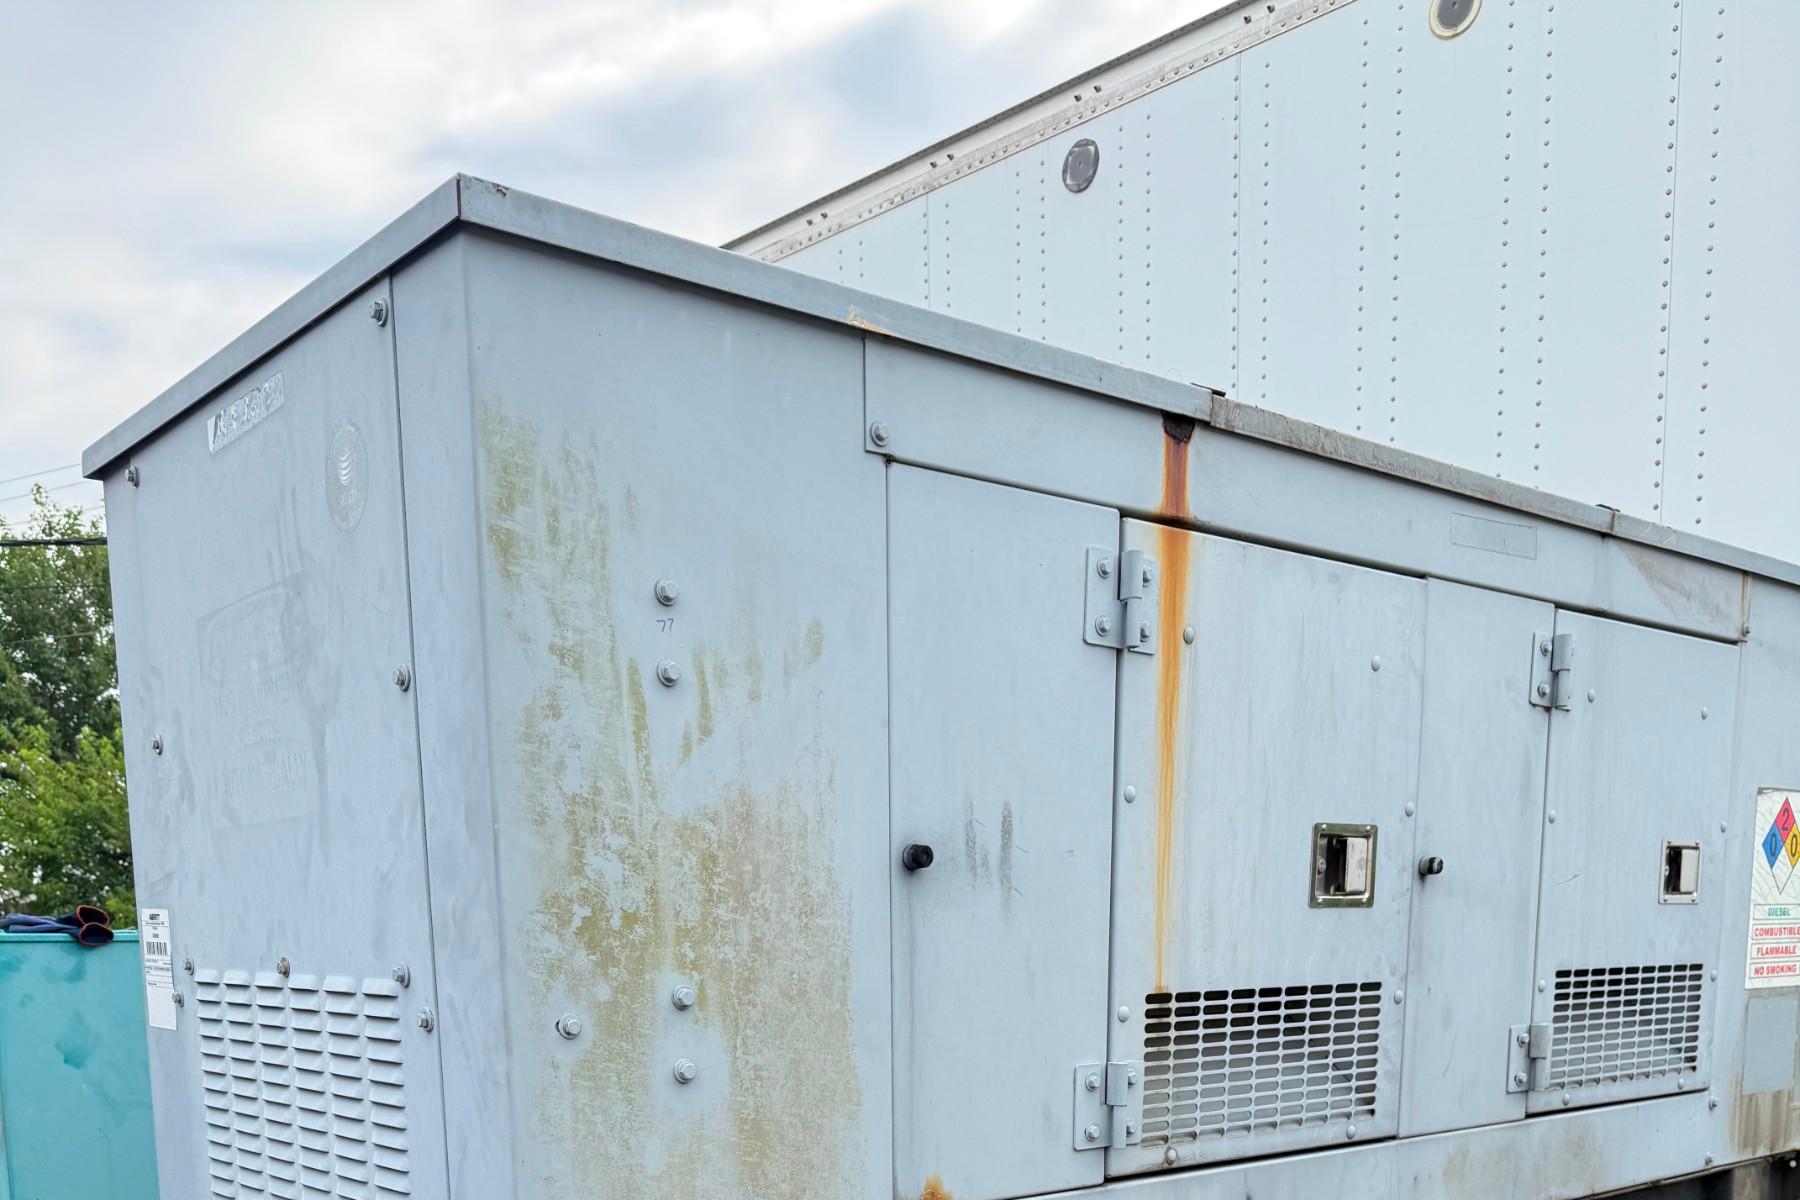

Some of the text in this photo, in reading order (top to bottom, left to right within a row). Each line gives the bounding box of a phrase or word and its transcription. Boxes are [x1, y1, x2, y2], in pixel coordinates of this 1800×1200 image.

[1781, 808, 1789, 831] 2
[1770, 832, 1777, 857] 0
[1790, 833, 1798, 858] 0
[1767, 907, 1791, 917] DIESEL
[1754, 926, 1800, 937] COMBUSTIBLE
[1756, 945, 1797, 957] FLAMMABLE
[1754, 964, 1797, 976] NO SMOKING
